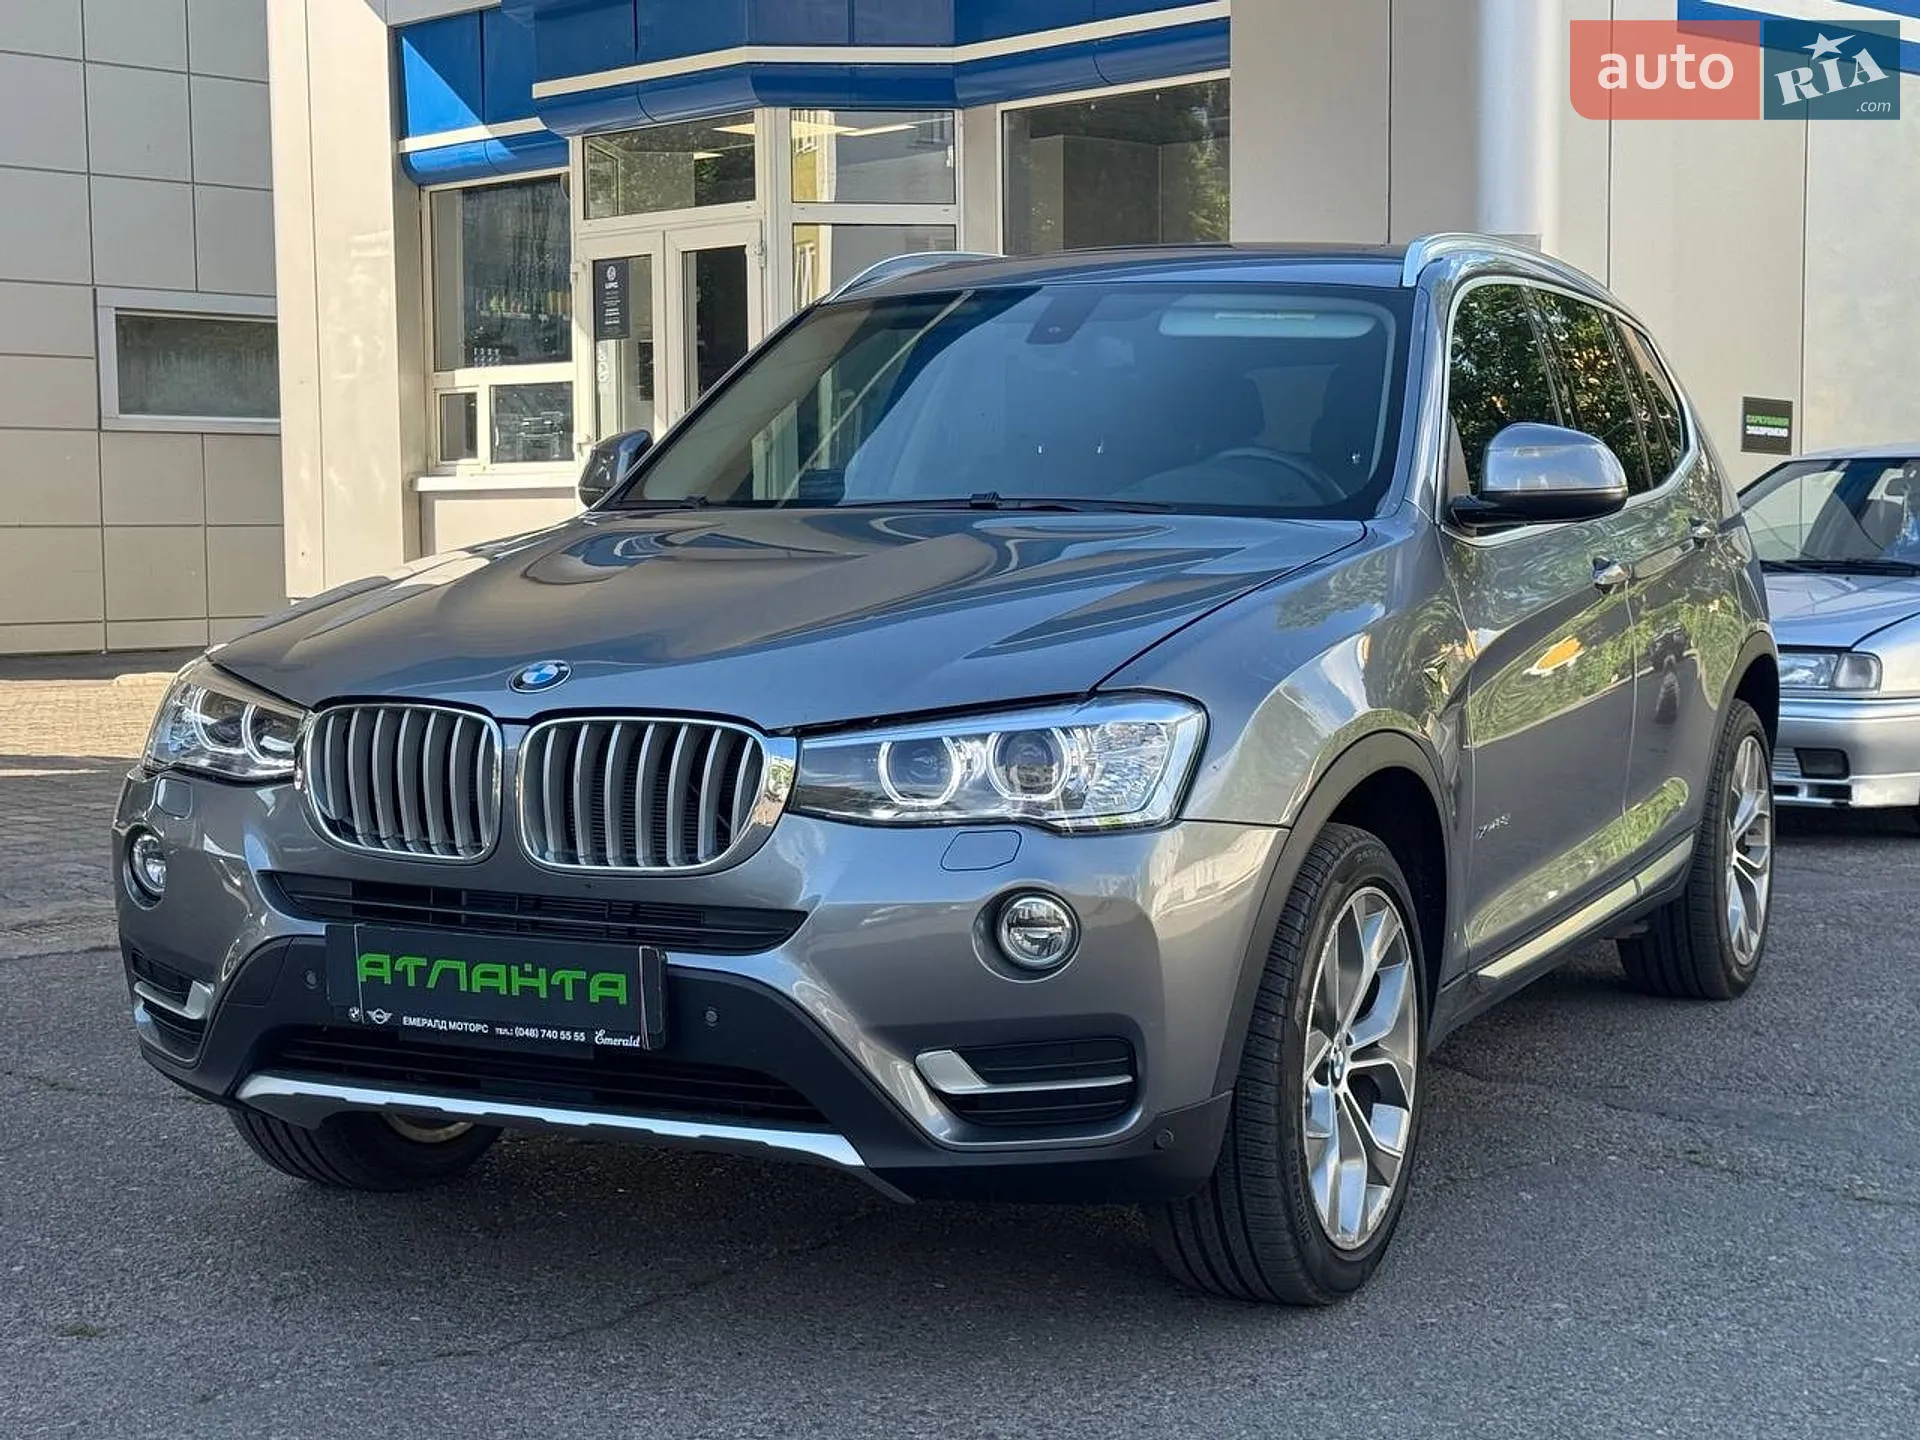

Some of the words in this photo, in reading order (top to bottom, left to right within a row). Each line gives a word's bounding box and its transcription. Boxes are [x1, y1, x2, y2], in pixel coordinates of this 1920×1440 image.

[402, 1015, 448, 1031] ЕМЕРАЛД
[448, 1021, 489, 1034] МОТОРС
[540, 1029, 558, 1040] 740
[559, 1030, 572, 1041] 55
[594, 1028, 641, 1048] Emerald
